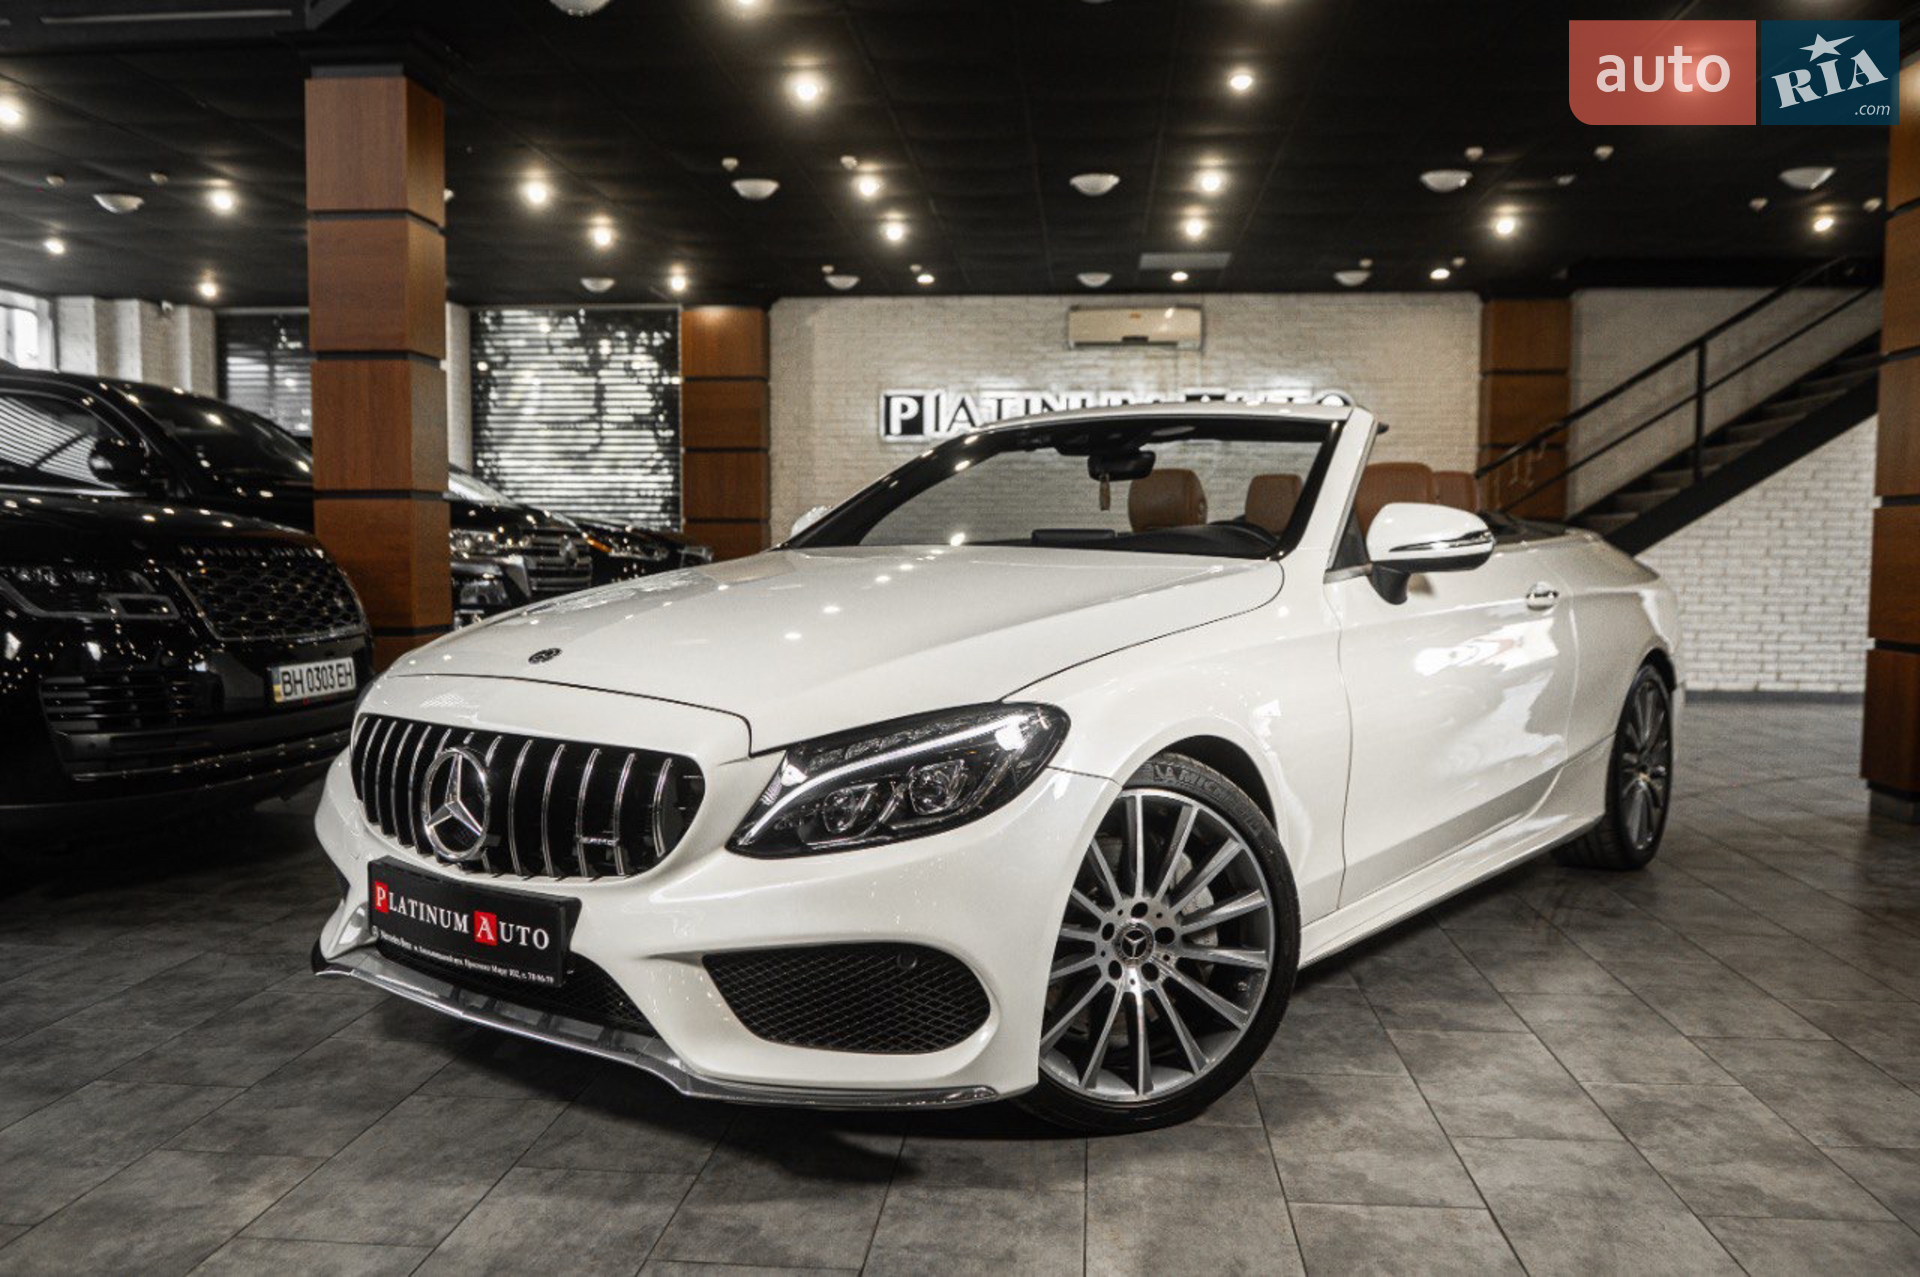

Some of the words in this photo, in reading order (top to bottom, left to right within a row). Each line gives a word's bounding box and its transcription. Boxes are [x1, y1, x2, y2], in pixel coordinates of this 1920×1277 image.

[281, 668, 305, 696] BH
[306, 664, 336, 692] 0303
[336, 661, 354, 688] EH
[375, 885, 470, 933] PLATINUM
[476, 916, 550, 951] AUTO
